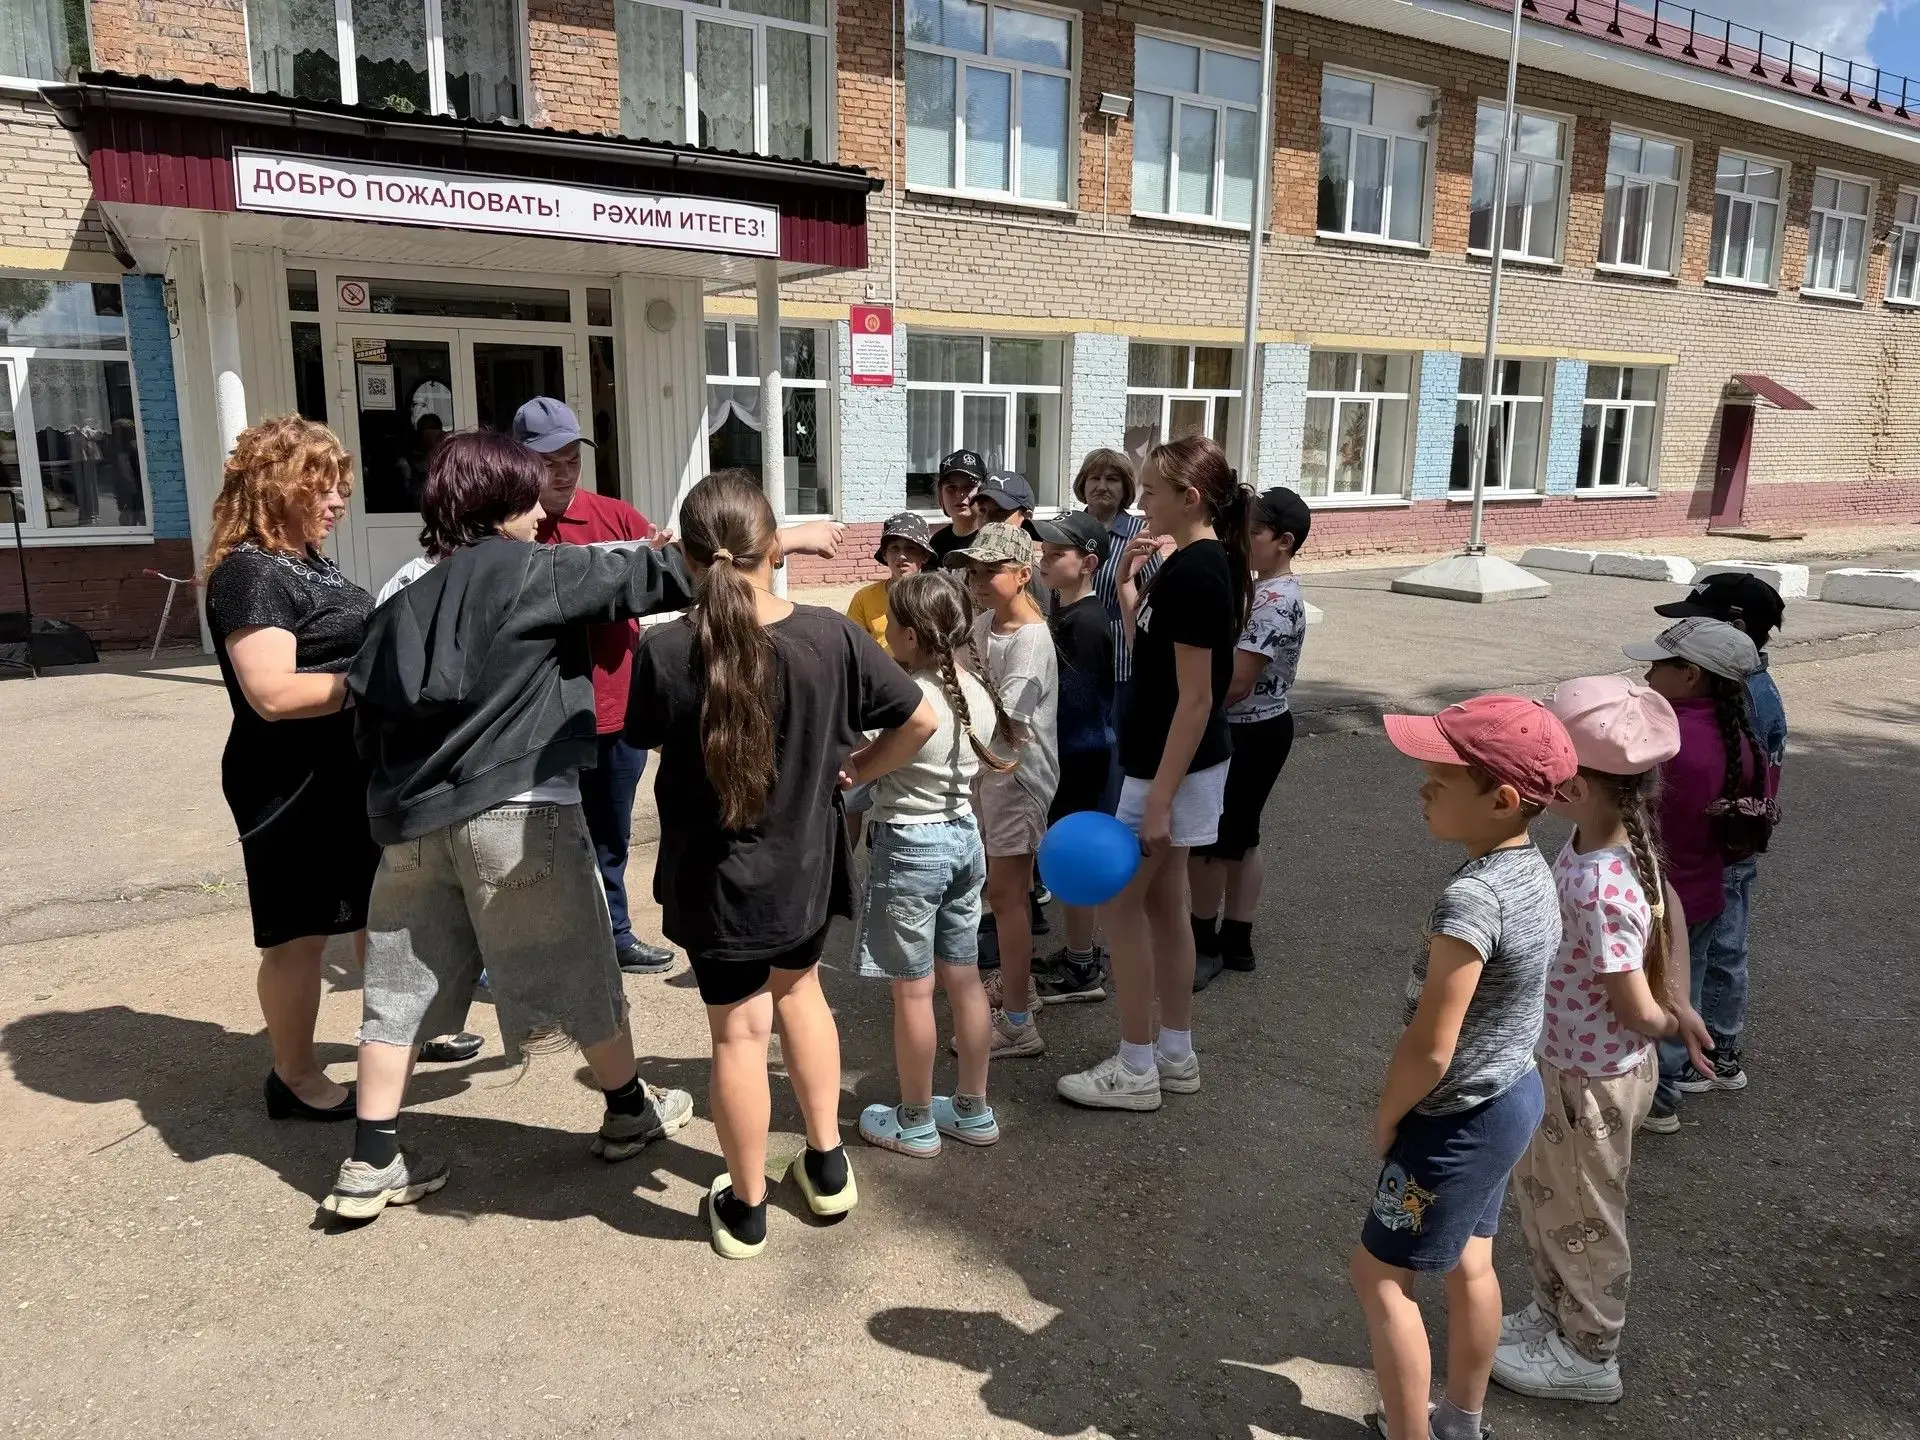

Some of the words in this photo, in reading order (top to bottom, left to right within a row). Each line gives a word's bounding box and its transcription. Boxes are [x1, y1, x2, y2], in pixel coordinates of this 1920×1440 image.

[254, 169, 357, 199] ДОБРО
[366, 181, 560, 218] ПОЖАЛОВАТЬ!
[593, 203, 672, 229] РӘХИМ
[680, 212, 766, 238] ИТЕГЕЗ!
